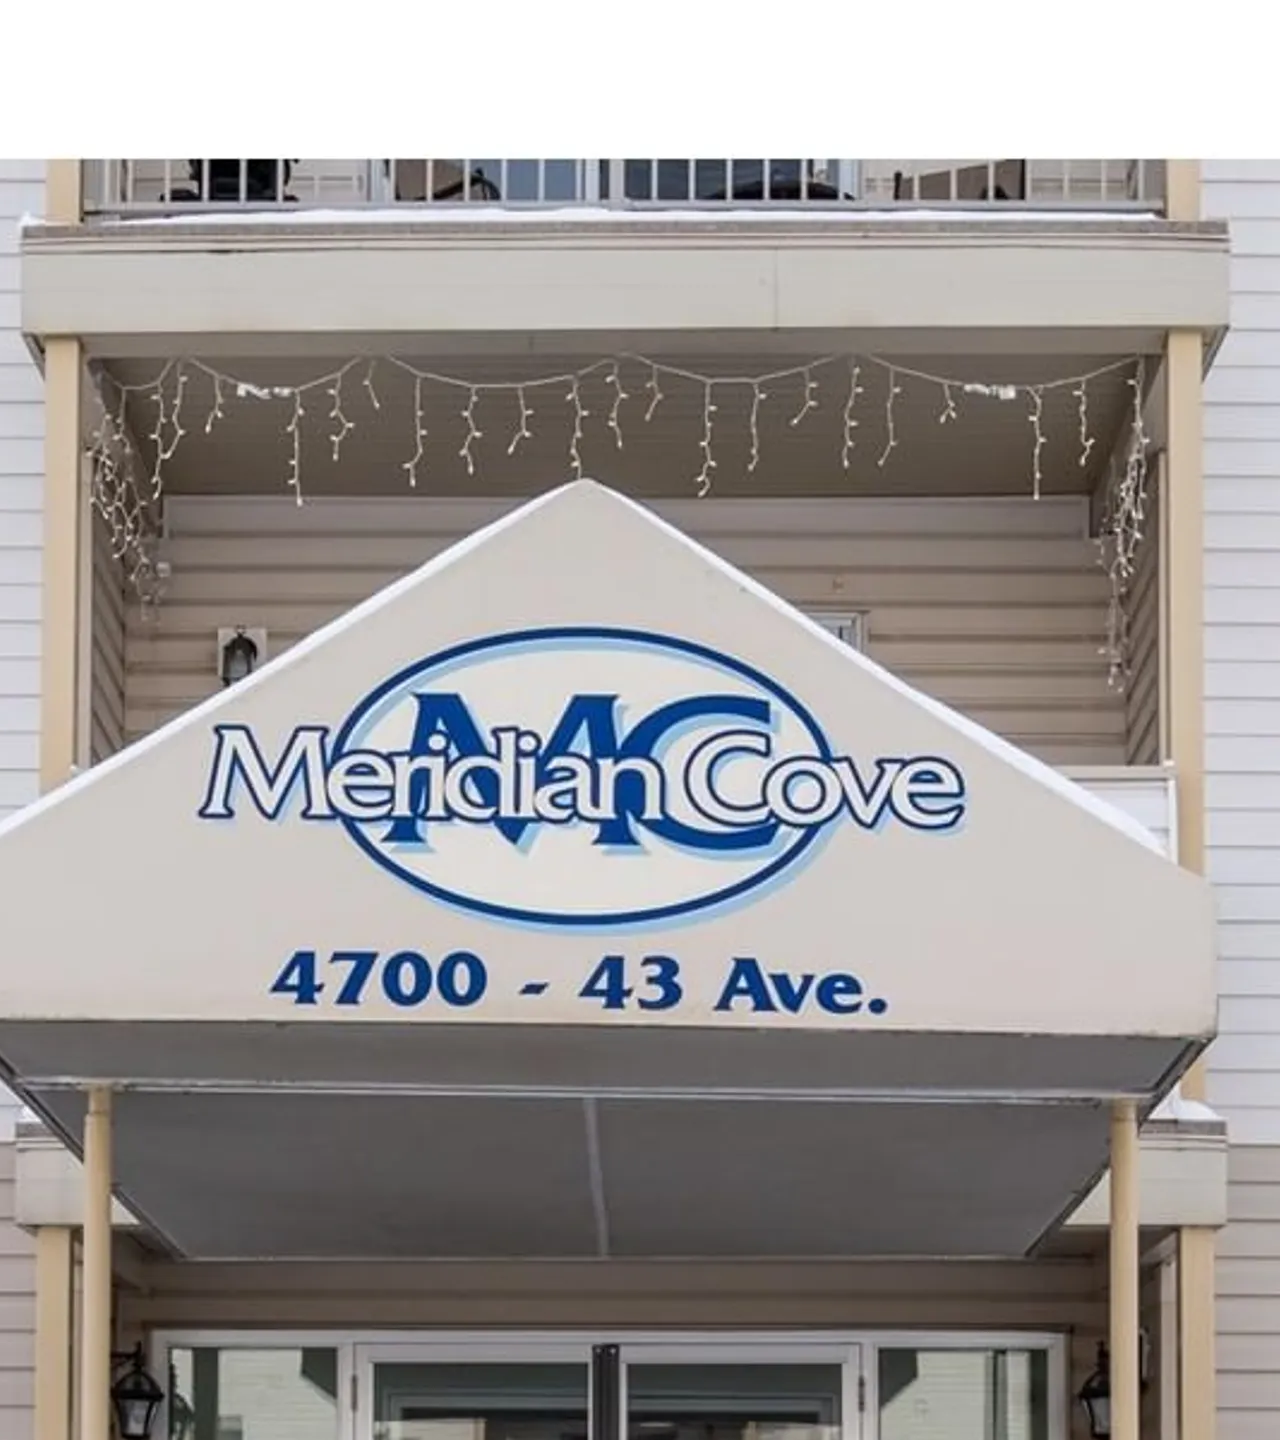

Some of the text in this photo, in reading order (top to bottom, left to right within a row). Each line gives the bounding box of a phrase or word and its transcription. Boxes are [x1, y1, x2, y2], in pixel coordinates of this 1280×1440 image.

[199, 725, 966, 830] Meridian Cove
[270, 951, 488, 1007] 4700
[579, 956, 682, 1011] 43
[712, 957, 888, 1014] Ave.
